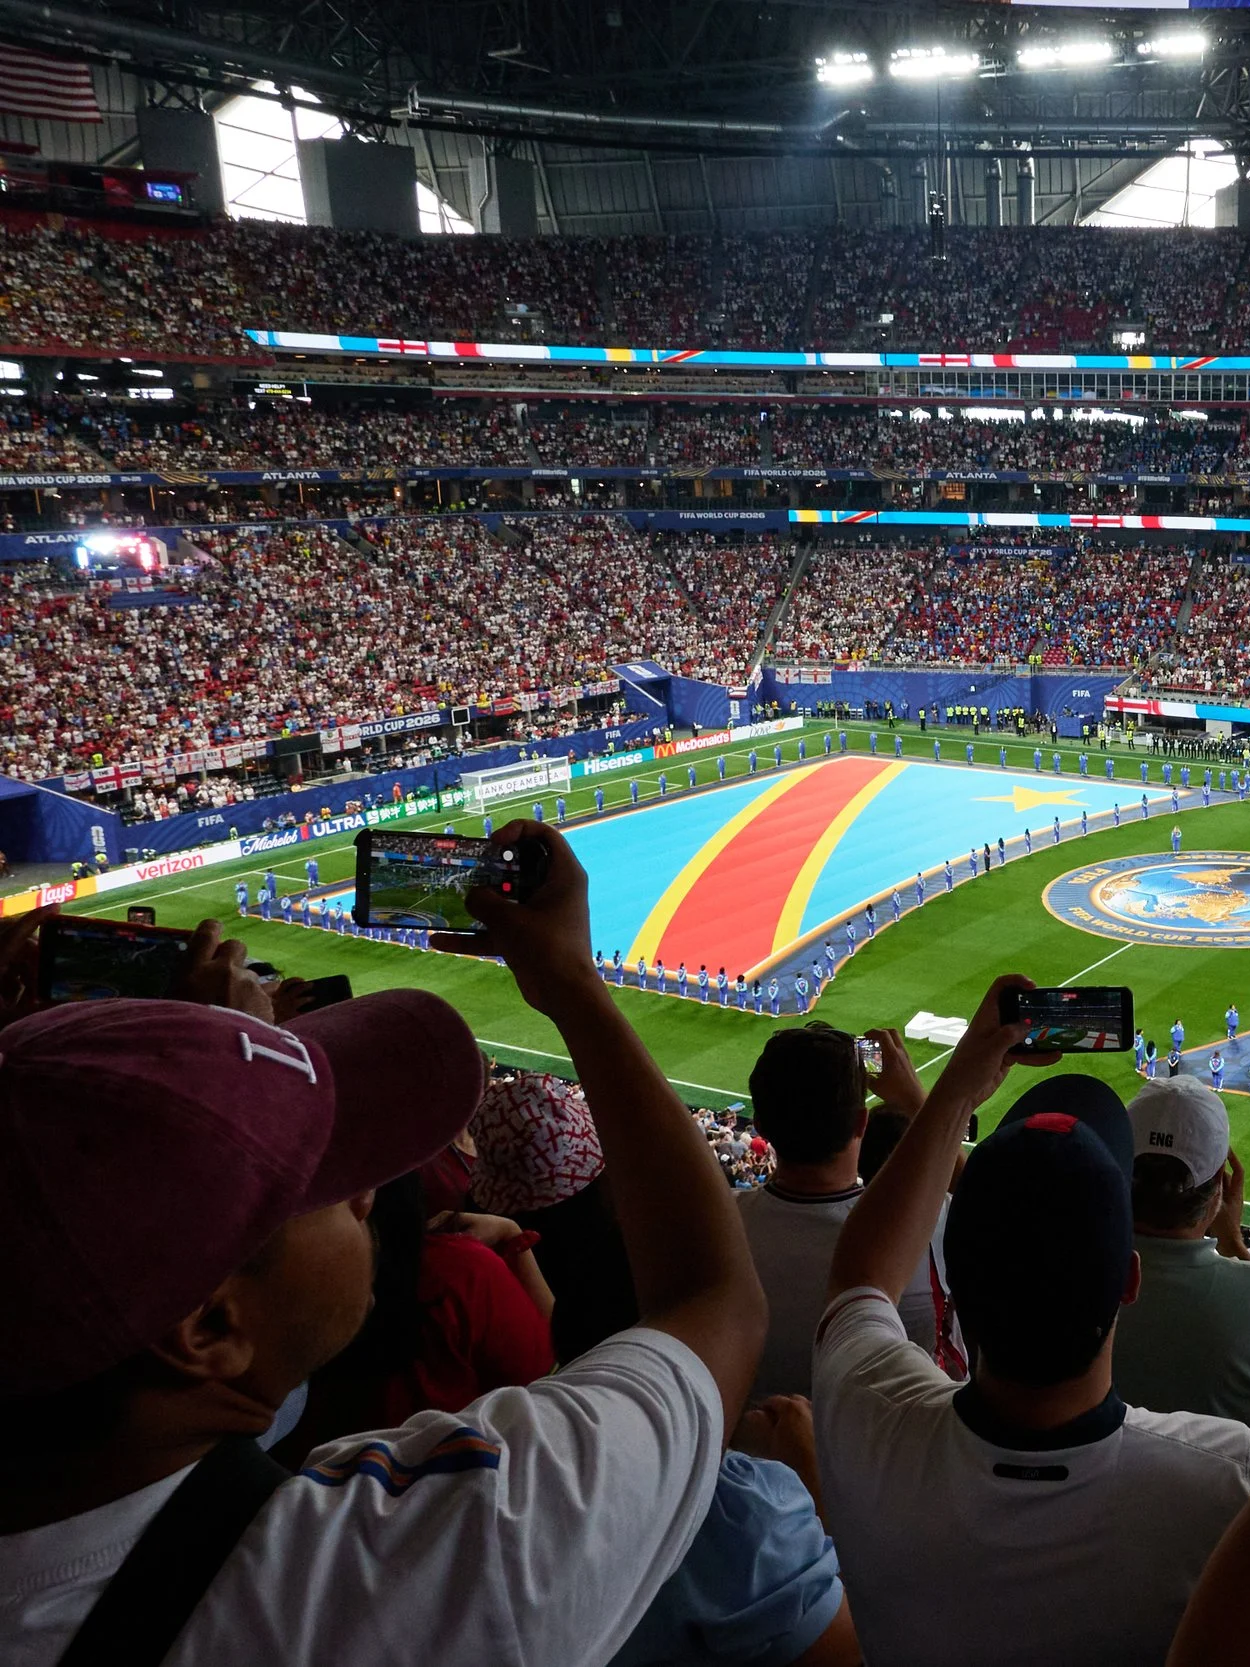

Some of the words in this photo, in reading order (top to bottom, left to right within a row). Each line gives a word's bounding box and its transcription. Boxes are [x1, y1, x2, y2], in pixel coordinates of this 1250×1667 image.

[0, 476, 16, 485] IFA
[19, 476, 54, 485] WORLD
[55, 475, 76, 484] CUP
[77, 475, 111, 484] 2026
[262, 471, 320, 481] ATLANTA
[946, 472, 997, 480] ATLANTA
[679, 512, 696, 520] FIFA
[697, 512, 723, 520] WORLD
[724, 512, 739, 520] CUP
[1072, 689, 1090, 698] FIFA
[384, 720, 404, 731] CUP
[406, 713, 440, 728] 2026
[605, 729, 621, 740] FIFA
[676, 730, 730, 753] McDonald's
[584, 751, 642, 775] Hisense
[506, 782, 517, 793] OF
[197, 813, 225, 827] FIFA
[312, 813, 366, 837] ULTRA
[242, 829, 298, 856] Michelob
[136, 853, 204, 880] verizon
[1068, 867, 1112, 885] FIFA
[41, 883, 74, 907] Lay's
[1068, 906, 1095, 921] FIFA
[1091, 917, 1149, 938] WORLD
[1150, 933, 1193, 941] CUP
[1150, 1131, 1173, 1147] ENG
